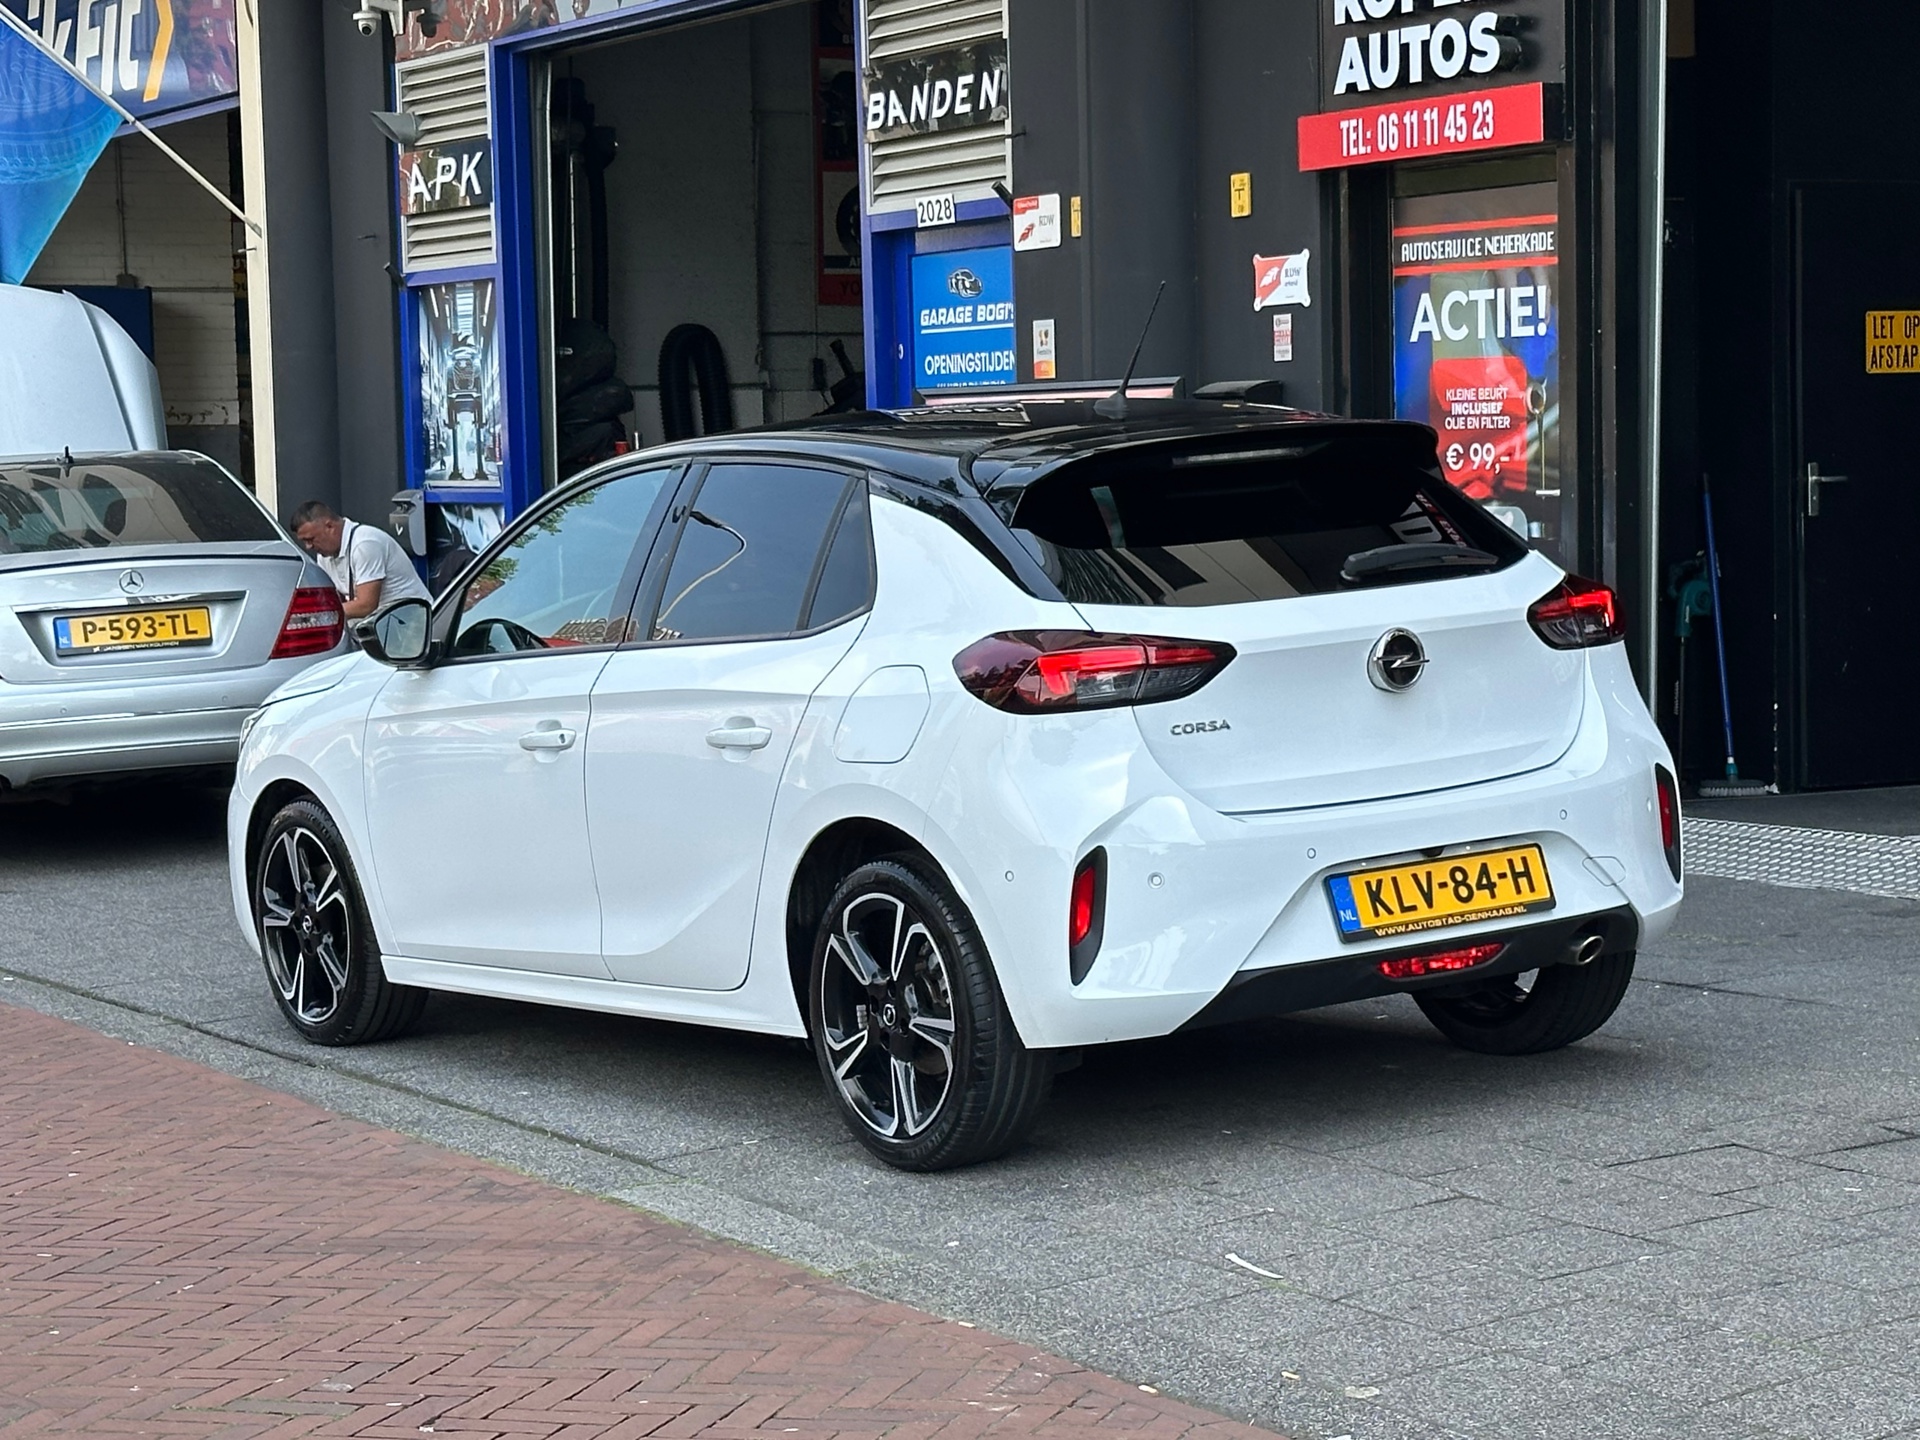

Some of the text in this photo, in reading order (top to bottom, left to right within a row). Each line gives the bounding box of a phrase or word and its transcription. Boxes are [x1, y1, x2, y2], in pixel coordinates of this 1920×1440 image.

[1333, 11, 1501, 95] AUTOS
[866, 69, 1001, 130] BANDEN
[1339, 99, 1494, 157] TEL: 06 11 11 45 23
[409, 151, 483, 202] APK
[918, 198, 952, 223] 2028
[1401, 230, 1555, 262] AUTOSERVICE NEHERKADE
[920, 305, 973, 326] GARAGE
[1409, 285, 1548, 343] ACTIE!
[1872, 315, 1920, 339] LET OP
[1870, 344, 1919, 369] AFSTAP
[1445, 386, 1509, 402] KLEINE BEURT
[1451, 402, 1503, 415] INCLUSIEF
[1445, 415, 1510, 430] OLIE EN FILTER
[1446, 442, 1510, 474] € 99,-
[81, 613, 199, 643] P-593-TL
[1170, 719, 1231, 736] CORSA
[1364, 855, 1536, 918] KLV-84-H
[1340, 909, 1357, 922] NL
[1375, 905, 1527, 937] WWW.AUTOSTAD-DENHAAG.NL
